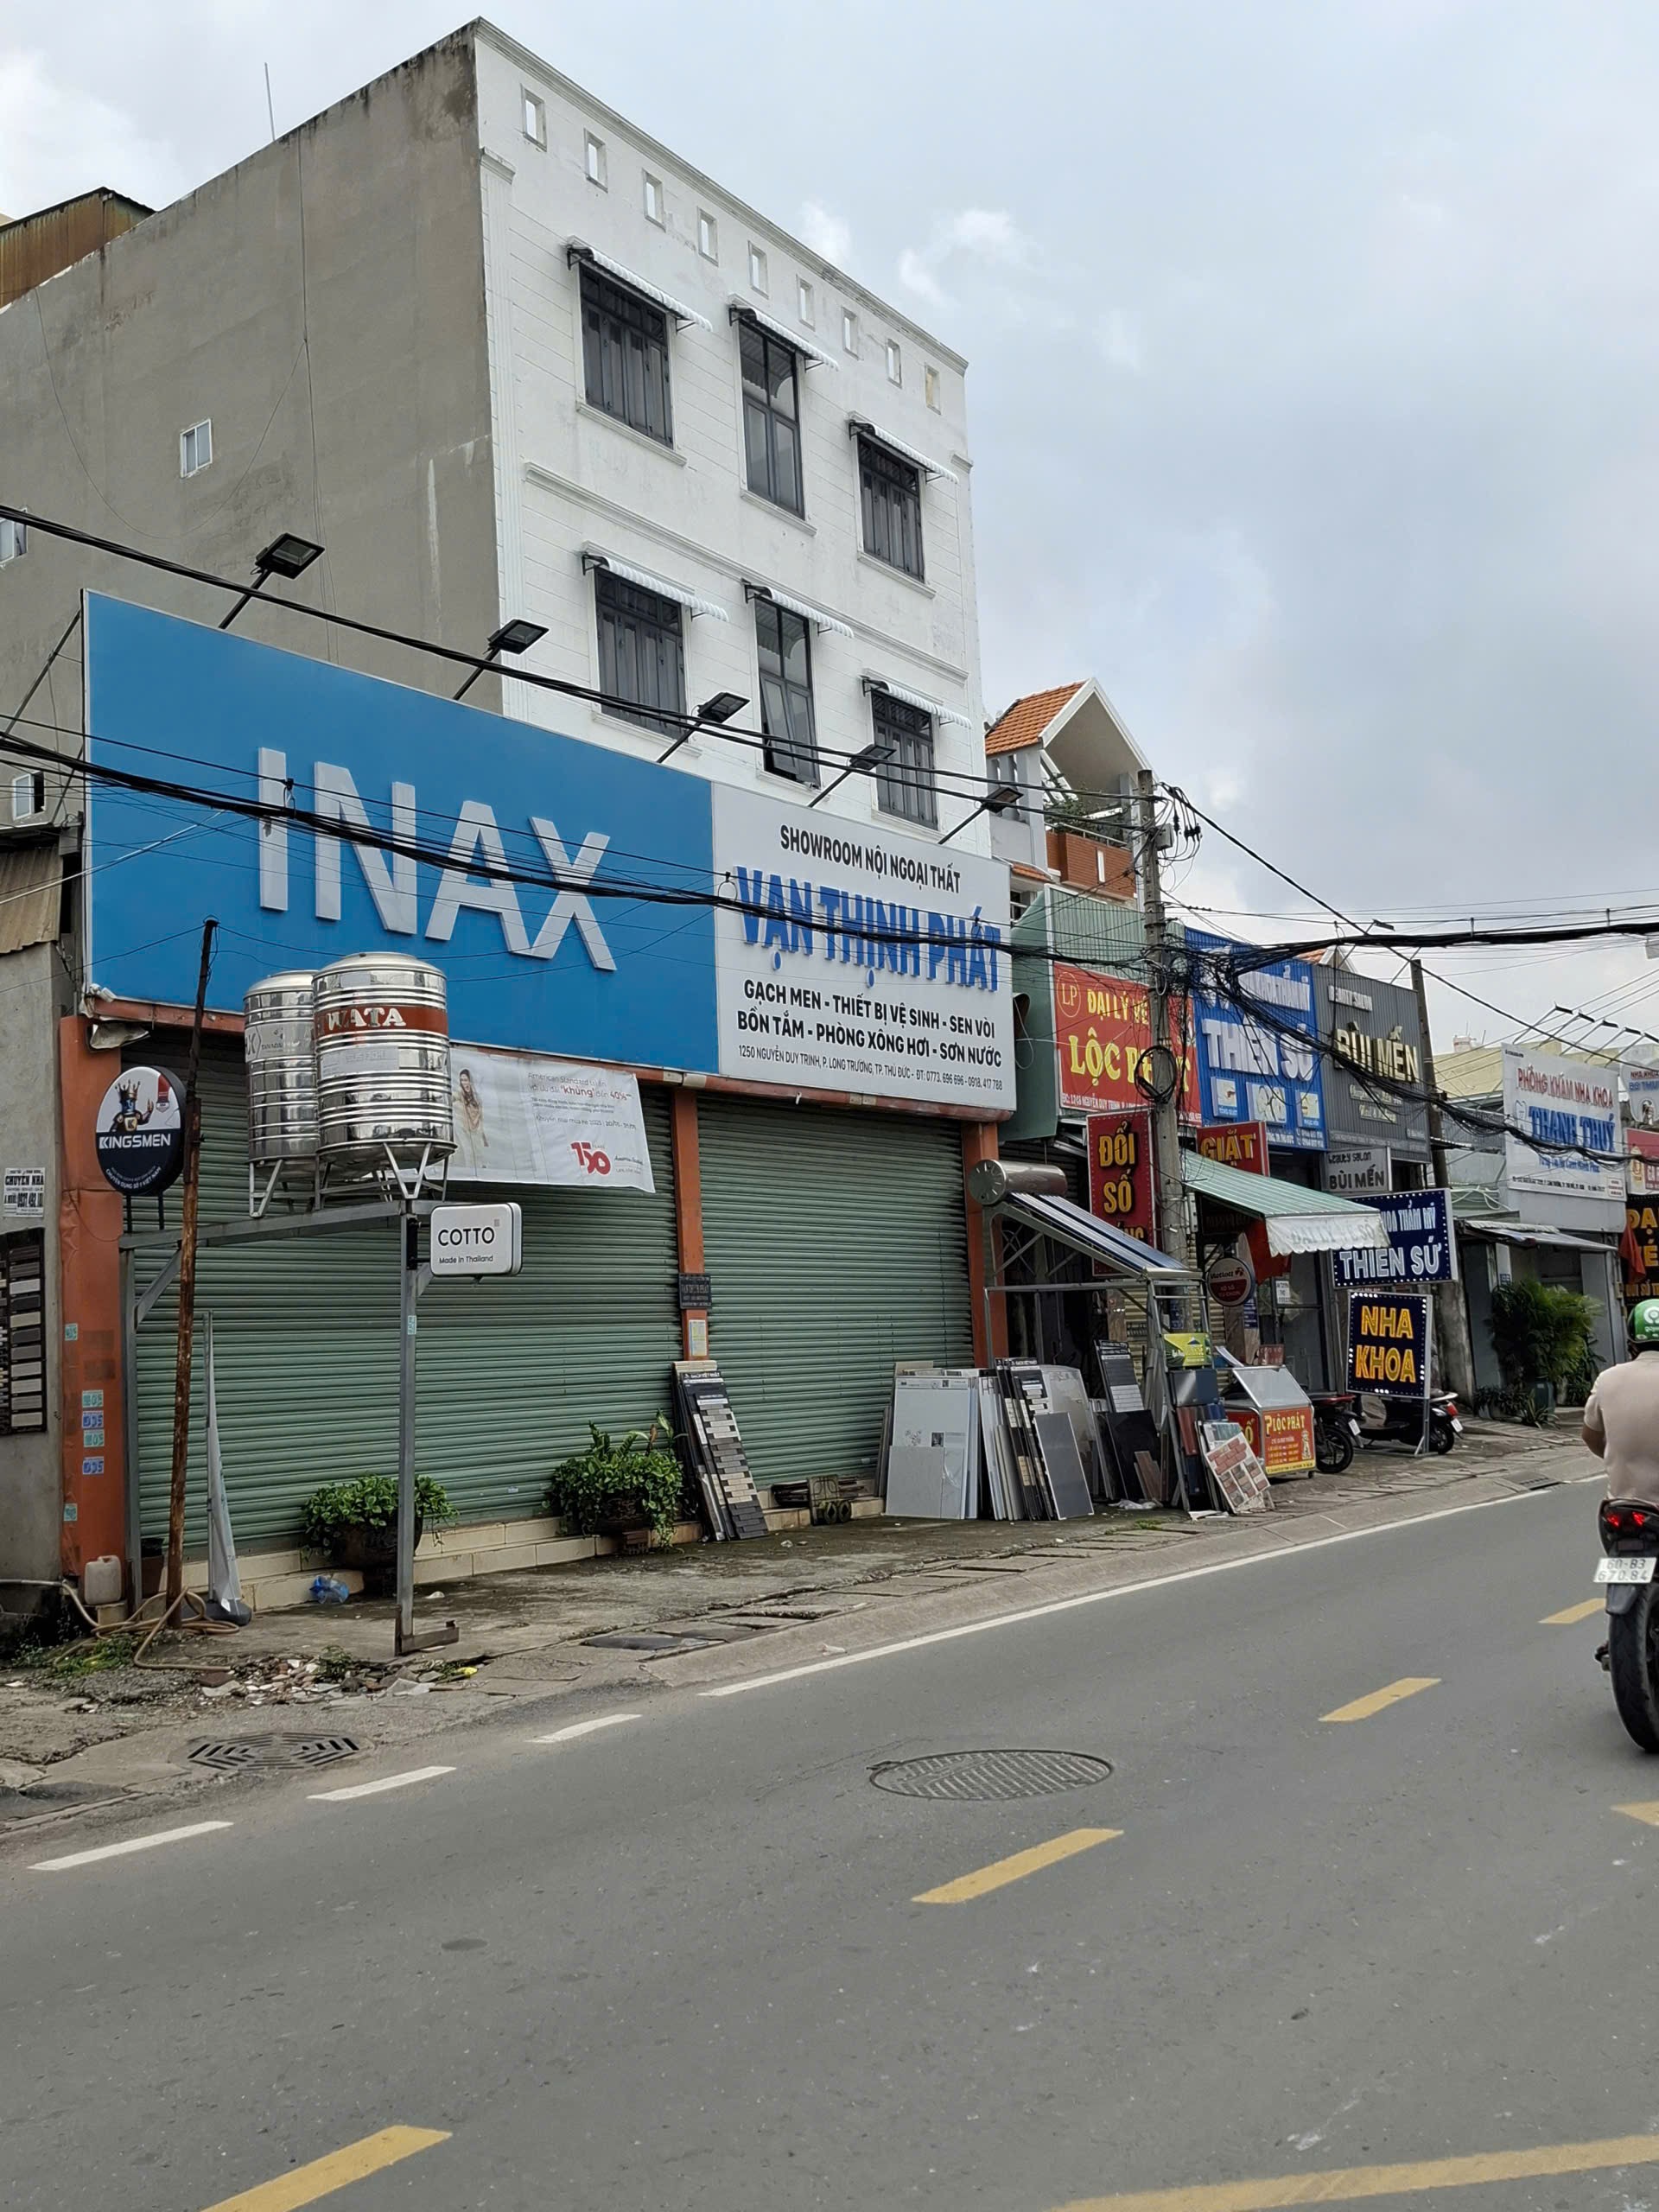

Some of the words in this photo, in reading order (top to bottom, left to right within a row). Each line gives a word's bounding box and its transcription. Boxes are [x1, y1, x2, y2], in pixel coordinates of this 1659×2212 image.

[258, 747, 617, 971] INAX
[780, 825, 862, 868] SHOWROOM
[865, 845, 887, 880] NỘI
[890, 855, 928, 890] NGOẠI
[931, 862, 960, 893] THẤT
[736, 866, 813, 970] VẠN
[817, 886, 920, 988] THỊNH
[926, 906, 1001, 992] PHÁT
[744, 979, 786, 1005] GẠCH
[791, 988, 821, 1010] MEN
[832, 993, 871, 1018] THIẾT
[874, 1002, 887, 1026] BỊ
[890, 1002, 906, 1028] VỆ
[910, 1008, 939, 1029] SINH
[950, 1015, 972, 1035] SEN
[976, 1017, 995, 1039] VÒI
[1061, 983, 1077, 1007] LP
[1087, 988, 1109, 1020] ĐẠI
[737, 1006, 769, 1033] BỒN
[772, 1010, 804, 1039] TẮM
[817, 1022, 864, 1047] PHÒNG
[868, 1028, 904, 1053] XÔNG
[907, 1037, 929, 1057] HƠI
[940, 1042, 965, 1062] SƠN
[968, 1046, 1001, 1067] NƯỚC
[1202, 1013, 1279, 1076] THIÊN
[1334, 1020, 1372, 1072] BÙI
[1374, 1026, 1421, 1084] MẾN
[739, 1045, 755, 1058] 1250
[756, 1045, 785, 1063] NGUYỄN
[785, 1052, 798, 1064] DUY
[800, 1053, 822, 1069] TRINH,
[829, 1058, 846, 1071] LONG
[874, 1064, 883, 1075] TP.
[898, 1065, 910, 1078] ĐỨC
[1069, 1027, 1121, 1086] LỘC
[1125, 1046, 1191, 1091] PHT
[1549, 1071, 1573, 1100] KHÁM
[1573, 1080, 1591, 1104] NHA
[1592, 1084, 1614, 1109] KHOA
[99, 1134, 171, 1149] KINGSMEN
[1099, 1121, 1135, 1166] ĐỔI
[1529, 1106, 1578, 1146] THANH
[1200, 1128, 1256, 1166] GIẶT
[1103, 1169, 1132, 1214] SỐ
[1329, 1170, 1352, 1190] BÙI
[1355, 1164, 1384, 1187] MẾN
[438, 1227, 494, 1246] COTTO
[1410, 1236, 1442, 1274] SỨ
[467, 1255, 493, 1263] Thailand
[1361, 1305, 1414, 1339] NHA
[1355, 1344, 1417, 1383] KHOA
